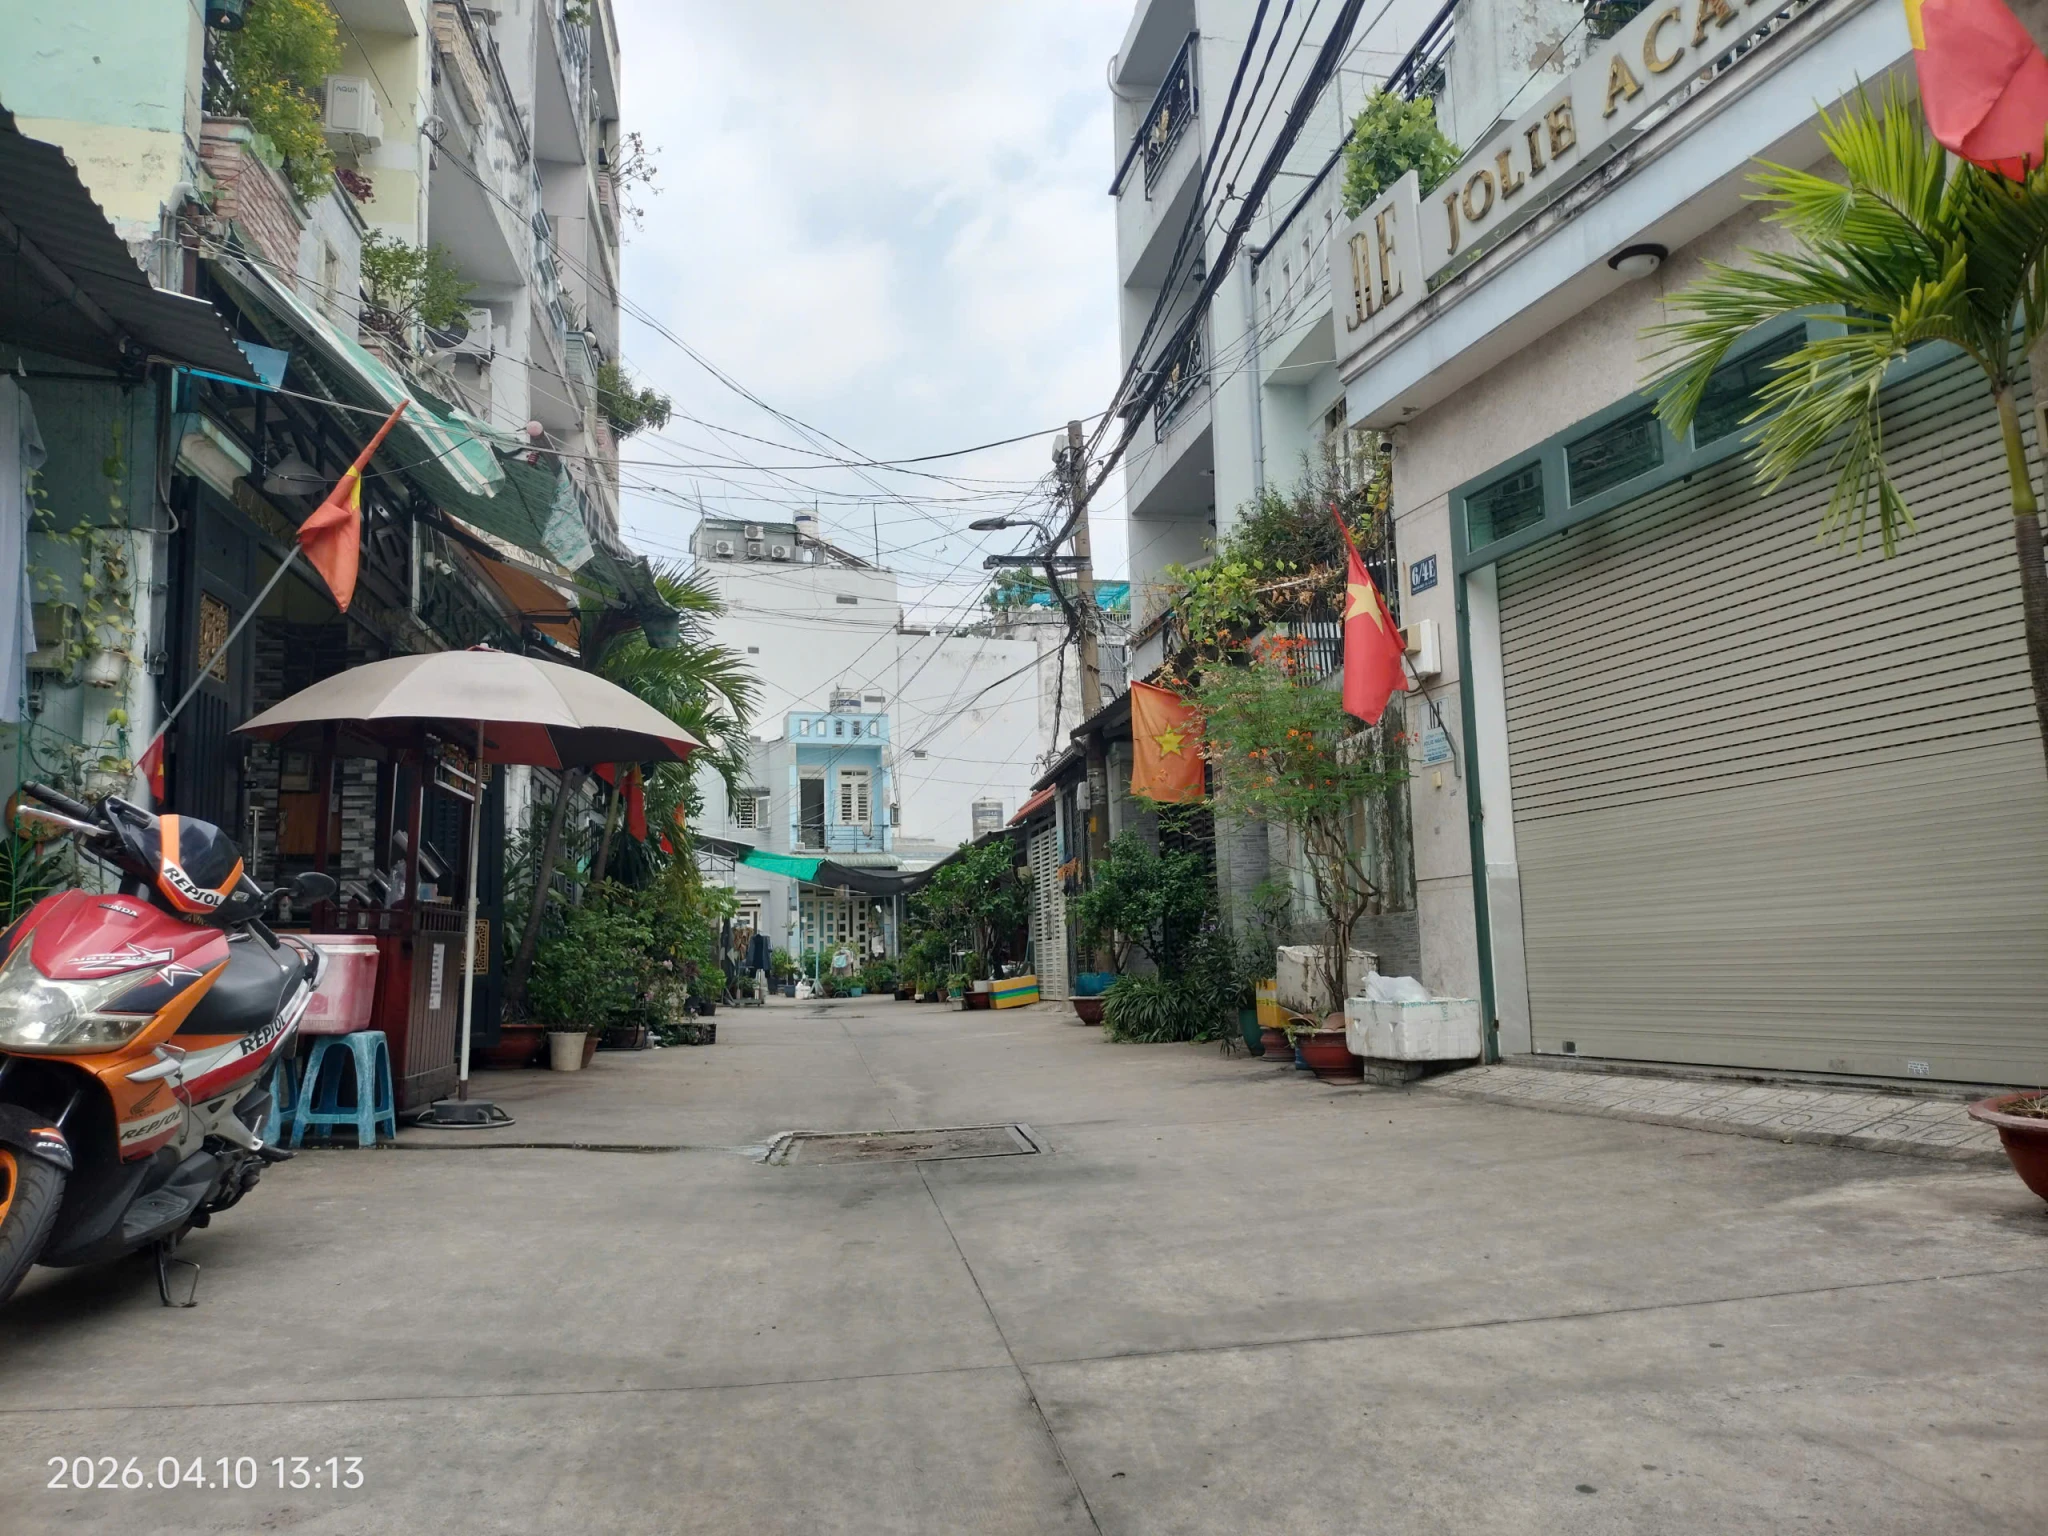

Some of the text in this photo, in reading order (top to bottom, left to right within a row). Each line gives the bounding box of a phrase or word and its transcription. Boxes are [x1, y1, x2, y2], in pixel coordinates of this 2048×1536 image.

[1443, 0, 1757, 255] JOLIE ACA
[1412, 559, 1436, 586] 6/4E
[164, 866, 220, 906] REPSOL
[98, 902, 138, 918] HONDA
[239, 1014, 286, 1056] REPSOL
[121, 1109, 181, 1140] REPSOL
